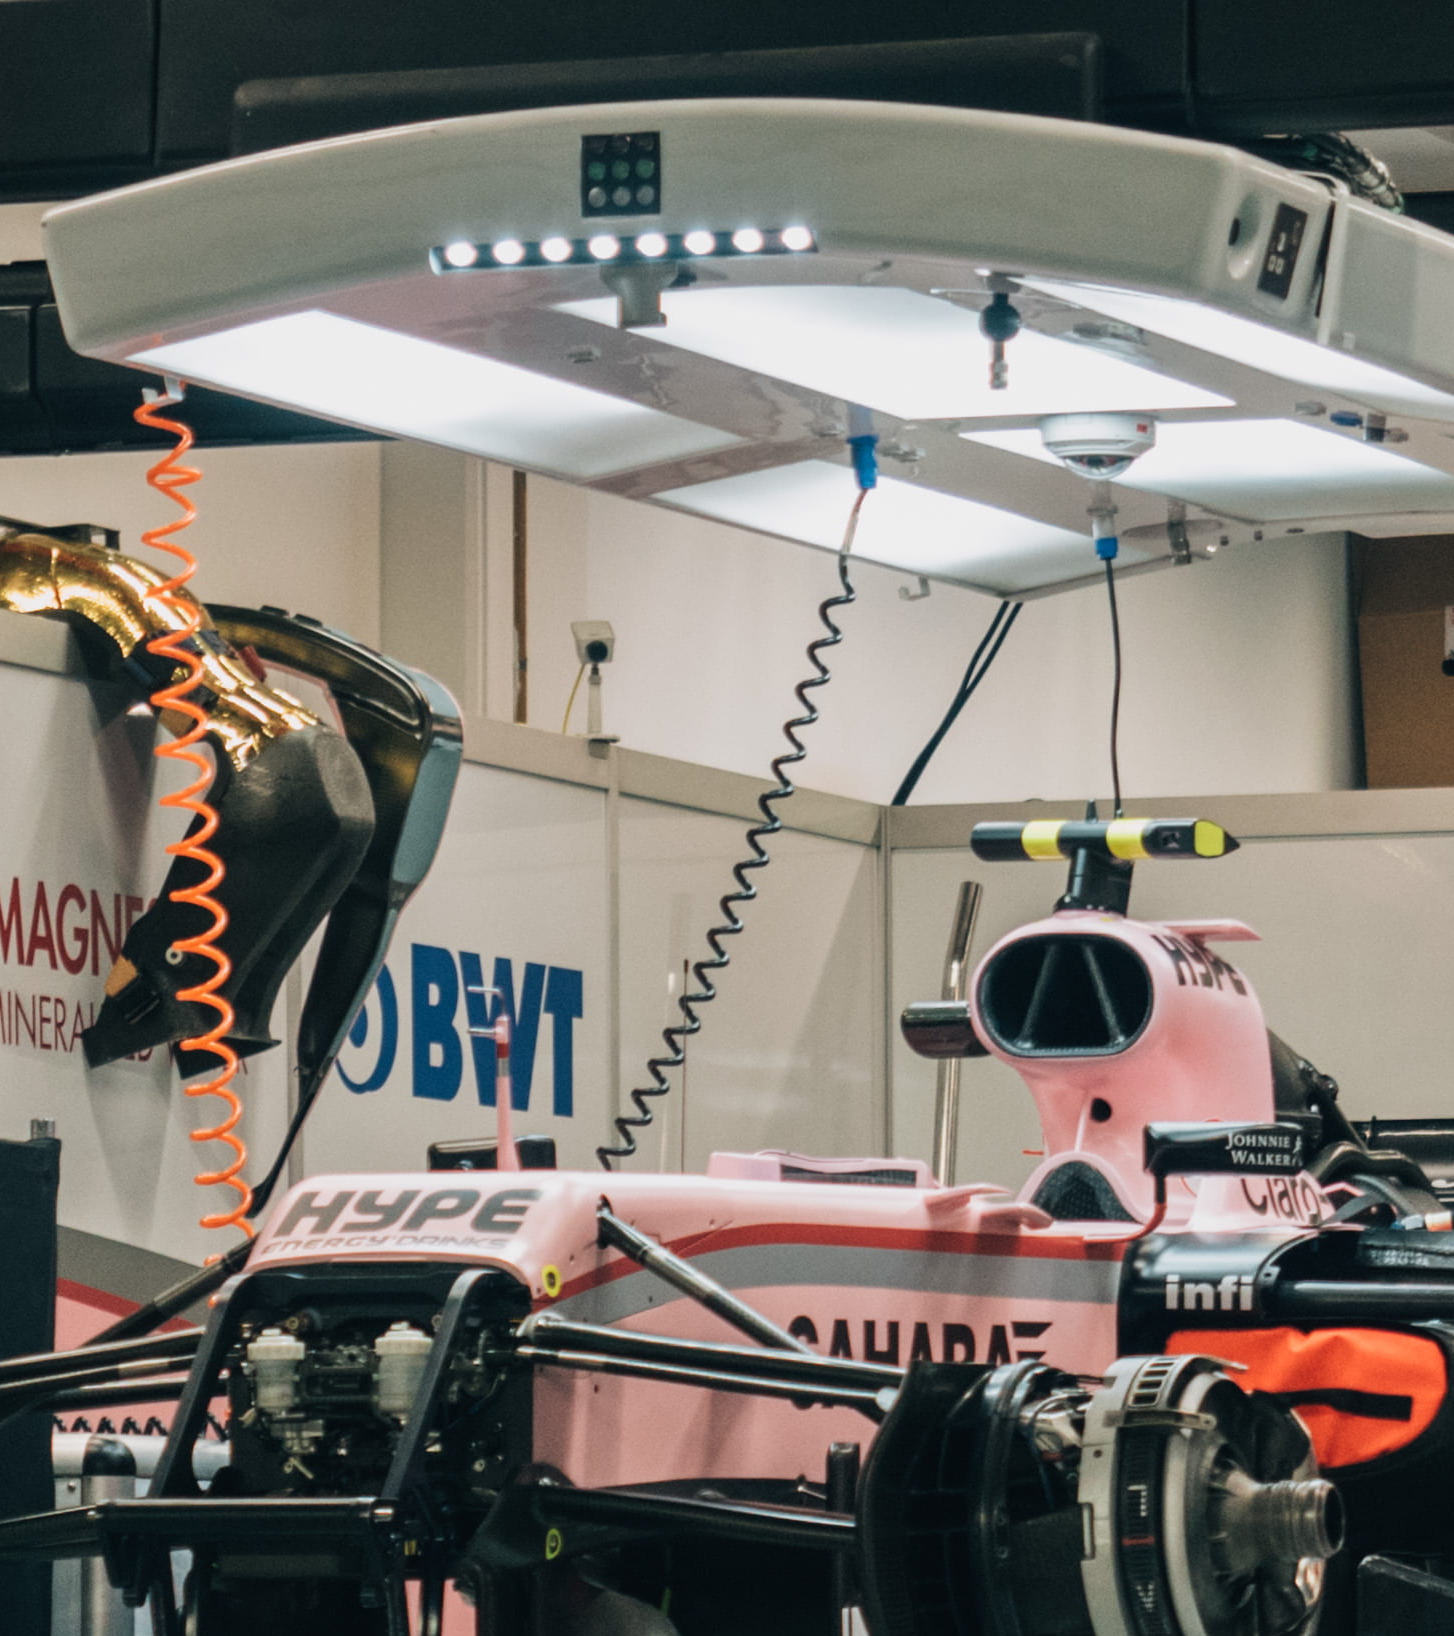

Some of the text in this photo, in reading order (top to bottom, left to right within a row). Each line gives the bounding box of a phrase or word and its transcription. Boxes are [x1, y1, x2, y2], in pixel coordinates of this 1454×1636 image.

[411, 942, 584, 1118] BWT
[1225, 1132, 1290, 1150] JOHNNIE
[1231, 1151, 1290, 1167] WALKER
[272, 1188, 544, 1238] HYPE
